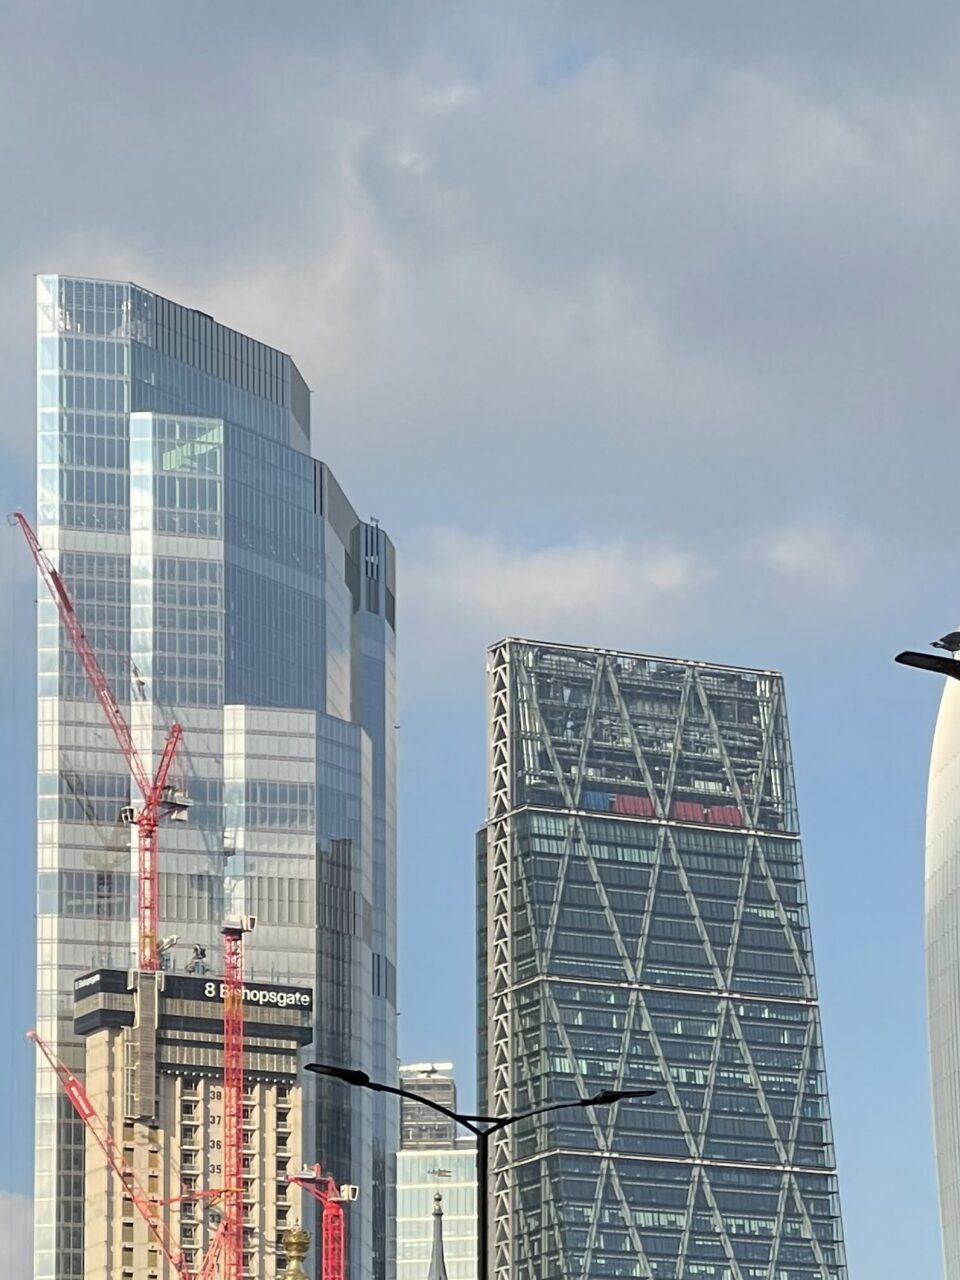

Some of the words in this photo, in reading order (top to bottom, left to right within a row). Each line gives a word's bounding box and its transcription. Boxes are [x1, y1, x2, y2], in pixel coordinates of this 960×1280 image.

[204, 982, 216, 998] 8
[209, 1090, 222, 1101] 38
[209, 1115, 222, 1125] 37
[209, 1140, 222, 1150] 36
[209, 1164, 222, 1174] 35
